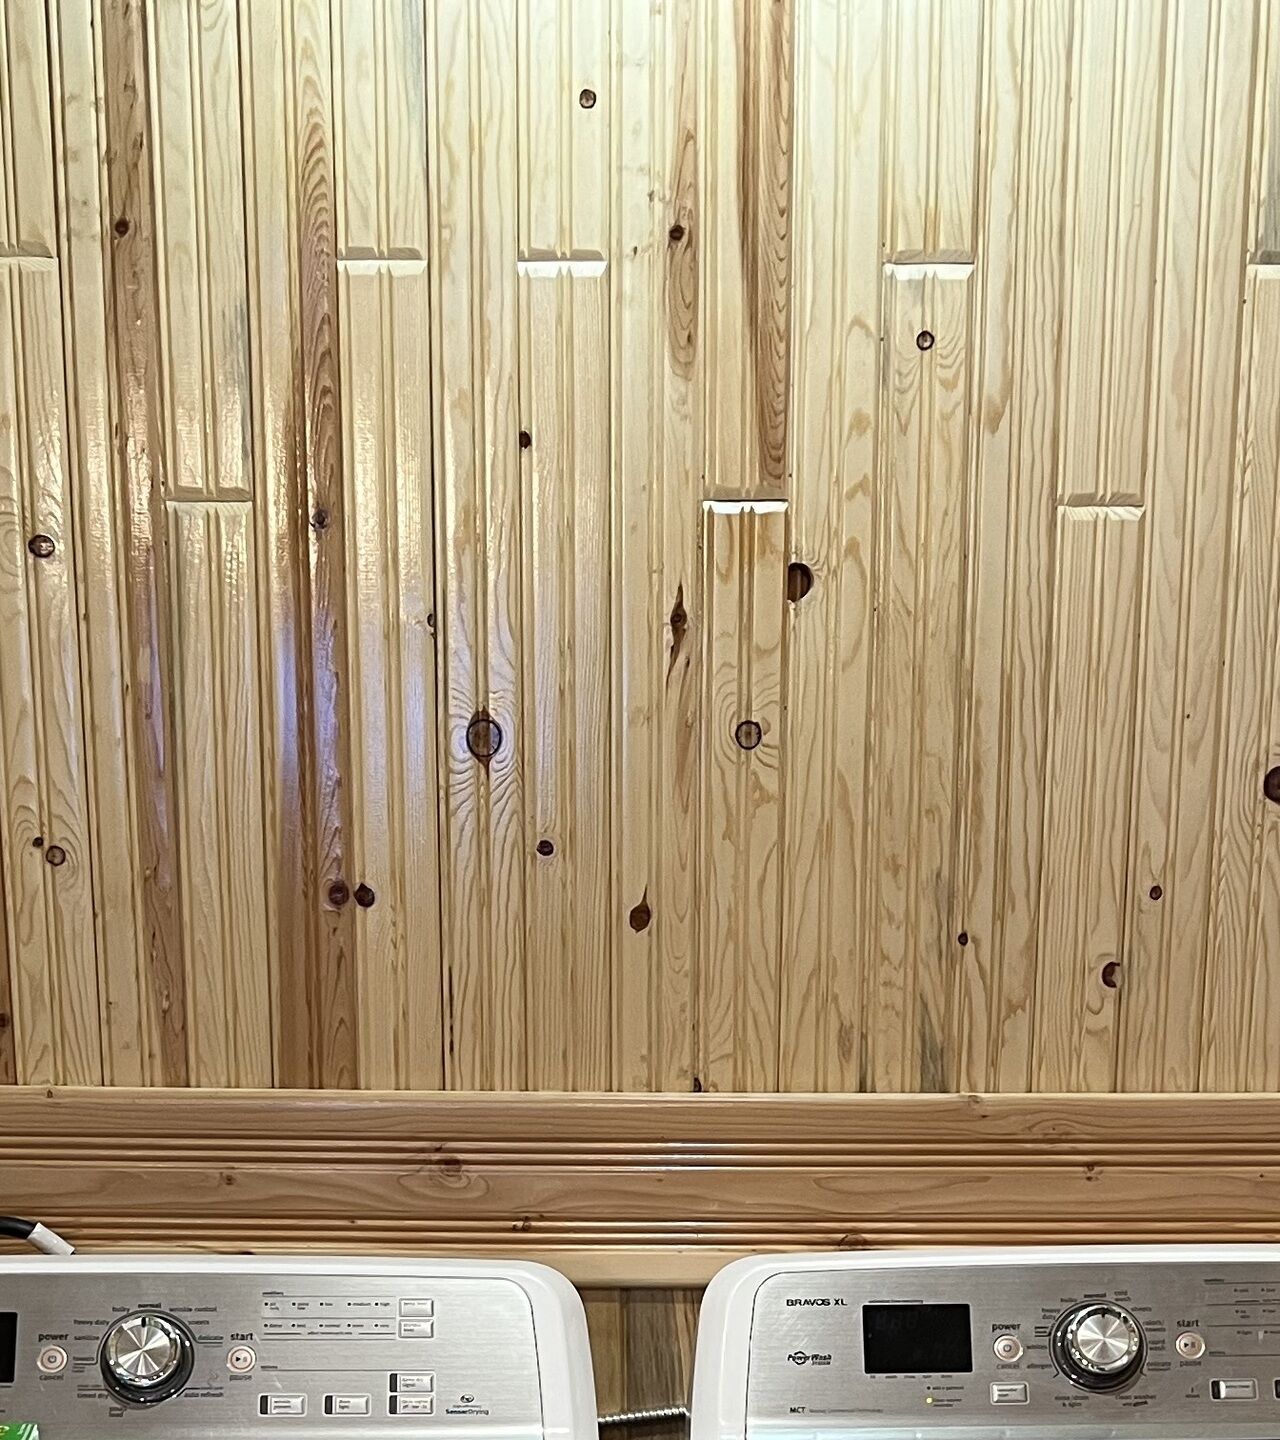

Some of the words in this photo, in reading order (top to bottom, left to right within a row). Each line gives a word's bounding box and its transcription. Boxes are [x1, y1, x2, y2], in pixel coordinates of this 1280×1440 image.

[786, 1298, 831, 1307] BRAVOS
[833, 1298, 848, 1307] XL
[991, 1323, 1021, 1333] power
[1176, 1319, 1200, 1328] start
[38, 1333, 69, 1343] power
[230, 1332, 253, 1341] start
[996, 1362, 1021, 1370] cancel
[39, 1374, 65, 1382] cancel
[789, 1406, 806, 1414] MCT
